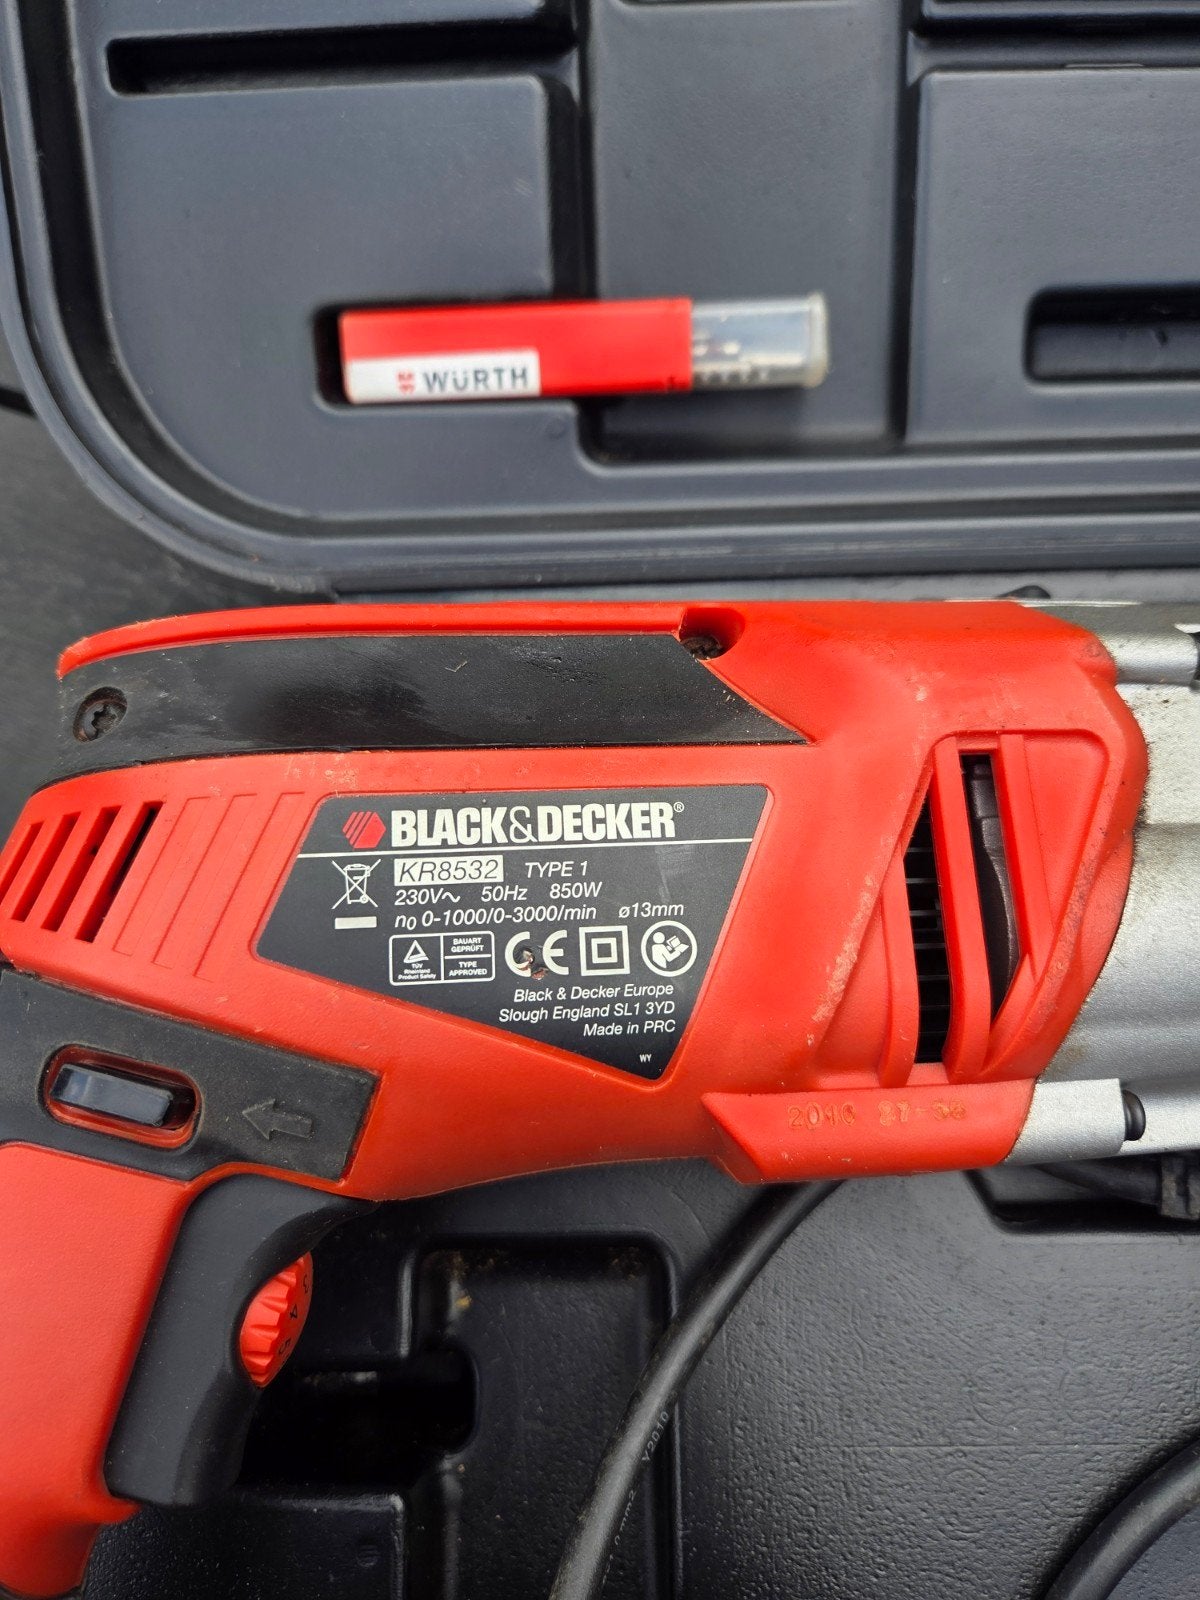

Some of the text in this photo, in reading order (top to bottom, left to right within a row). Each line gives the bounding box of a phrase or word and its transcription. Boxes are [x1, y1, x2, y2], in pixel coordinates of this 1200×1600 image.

[422, 366, 528, 393] WÜRTH
[399, 859, 588, 883] KR8532 TYPE 1
[481, 885, 528, 902] 50Hz
[550, 881, 602, 899] 850W
[421, 904, 597, 927] 0-1000/0-3000/min
[451, 944, 484, 953] GEPRÜFT
[453, 937, 482, 945] BAUART
[449, 968, 488, 977] APPROVED
[513, 983, 674, 1002] Black & Decker Europe
[499, 1001, 675, 1024] Slough England SL1 3YD
[583, 1019, 676, 1037] Made in PRC
[639, 1053, 652, 1063] WY
[641, 1411, 669, 1462] Y2010
